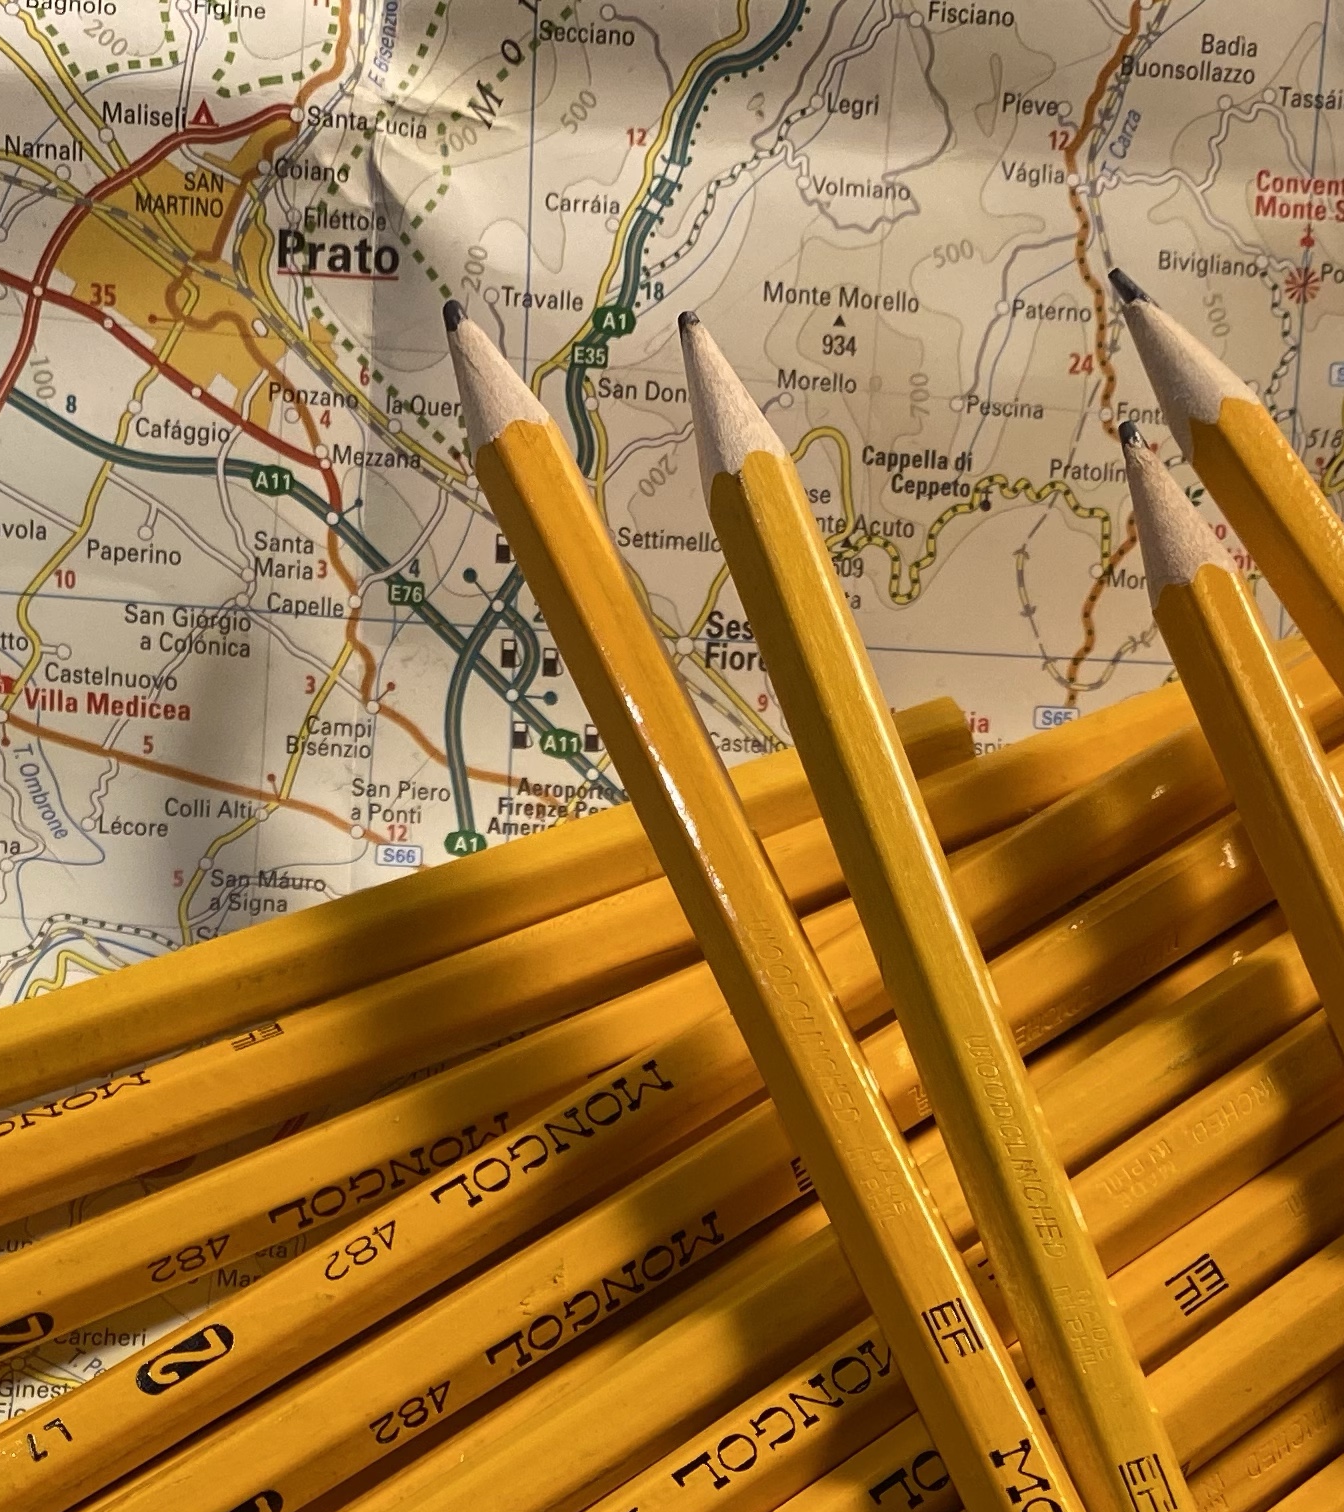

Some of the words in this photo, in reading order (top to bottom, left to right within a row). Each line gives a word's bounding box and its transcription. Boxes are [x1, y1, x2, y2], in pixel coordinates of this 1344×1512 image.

[184, 172, 225, 192] SAN
[812, 176, 910, 201] Volmiano
[136, 196, 224, 218] MARTINO
[1256, 199, 1328, 221] Monte
[278, 228, 400, 275] Prato
[502, 288, 584, 312] Travalle
[1012, 302, 1092, 324] Paterno
[575, 346, 606, 366] E35
[822, 334, 857, 358] 934
[862, 446, 950, 471] Cappella
[955, 451, 972, 474] di
[891, 475, 970, 500] Ceppeto
[87, 541, 181, 568] Paperino
[456, 836, 478, 853] A1
[431, 1061, 675, 1208] MONGOL
[268, 1111, 511, 1228] MONGOL
[324, 1220, 397, 1281] 482
[485, 1211, 726, 1369] MONGOL
[925, 1300, 982, 1362] EF
[369, 1379, 451, 1446] 482
[26, 1418, 74, 1462] L7
